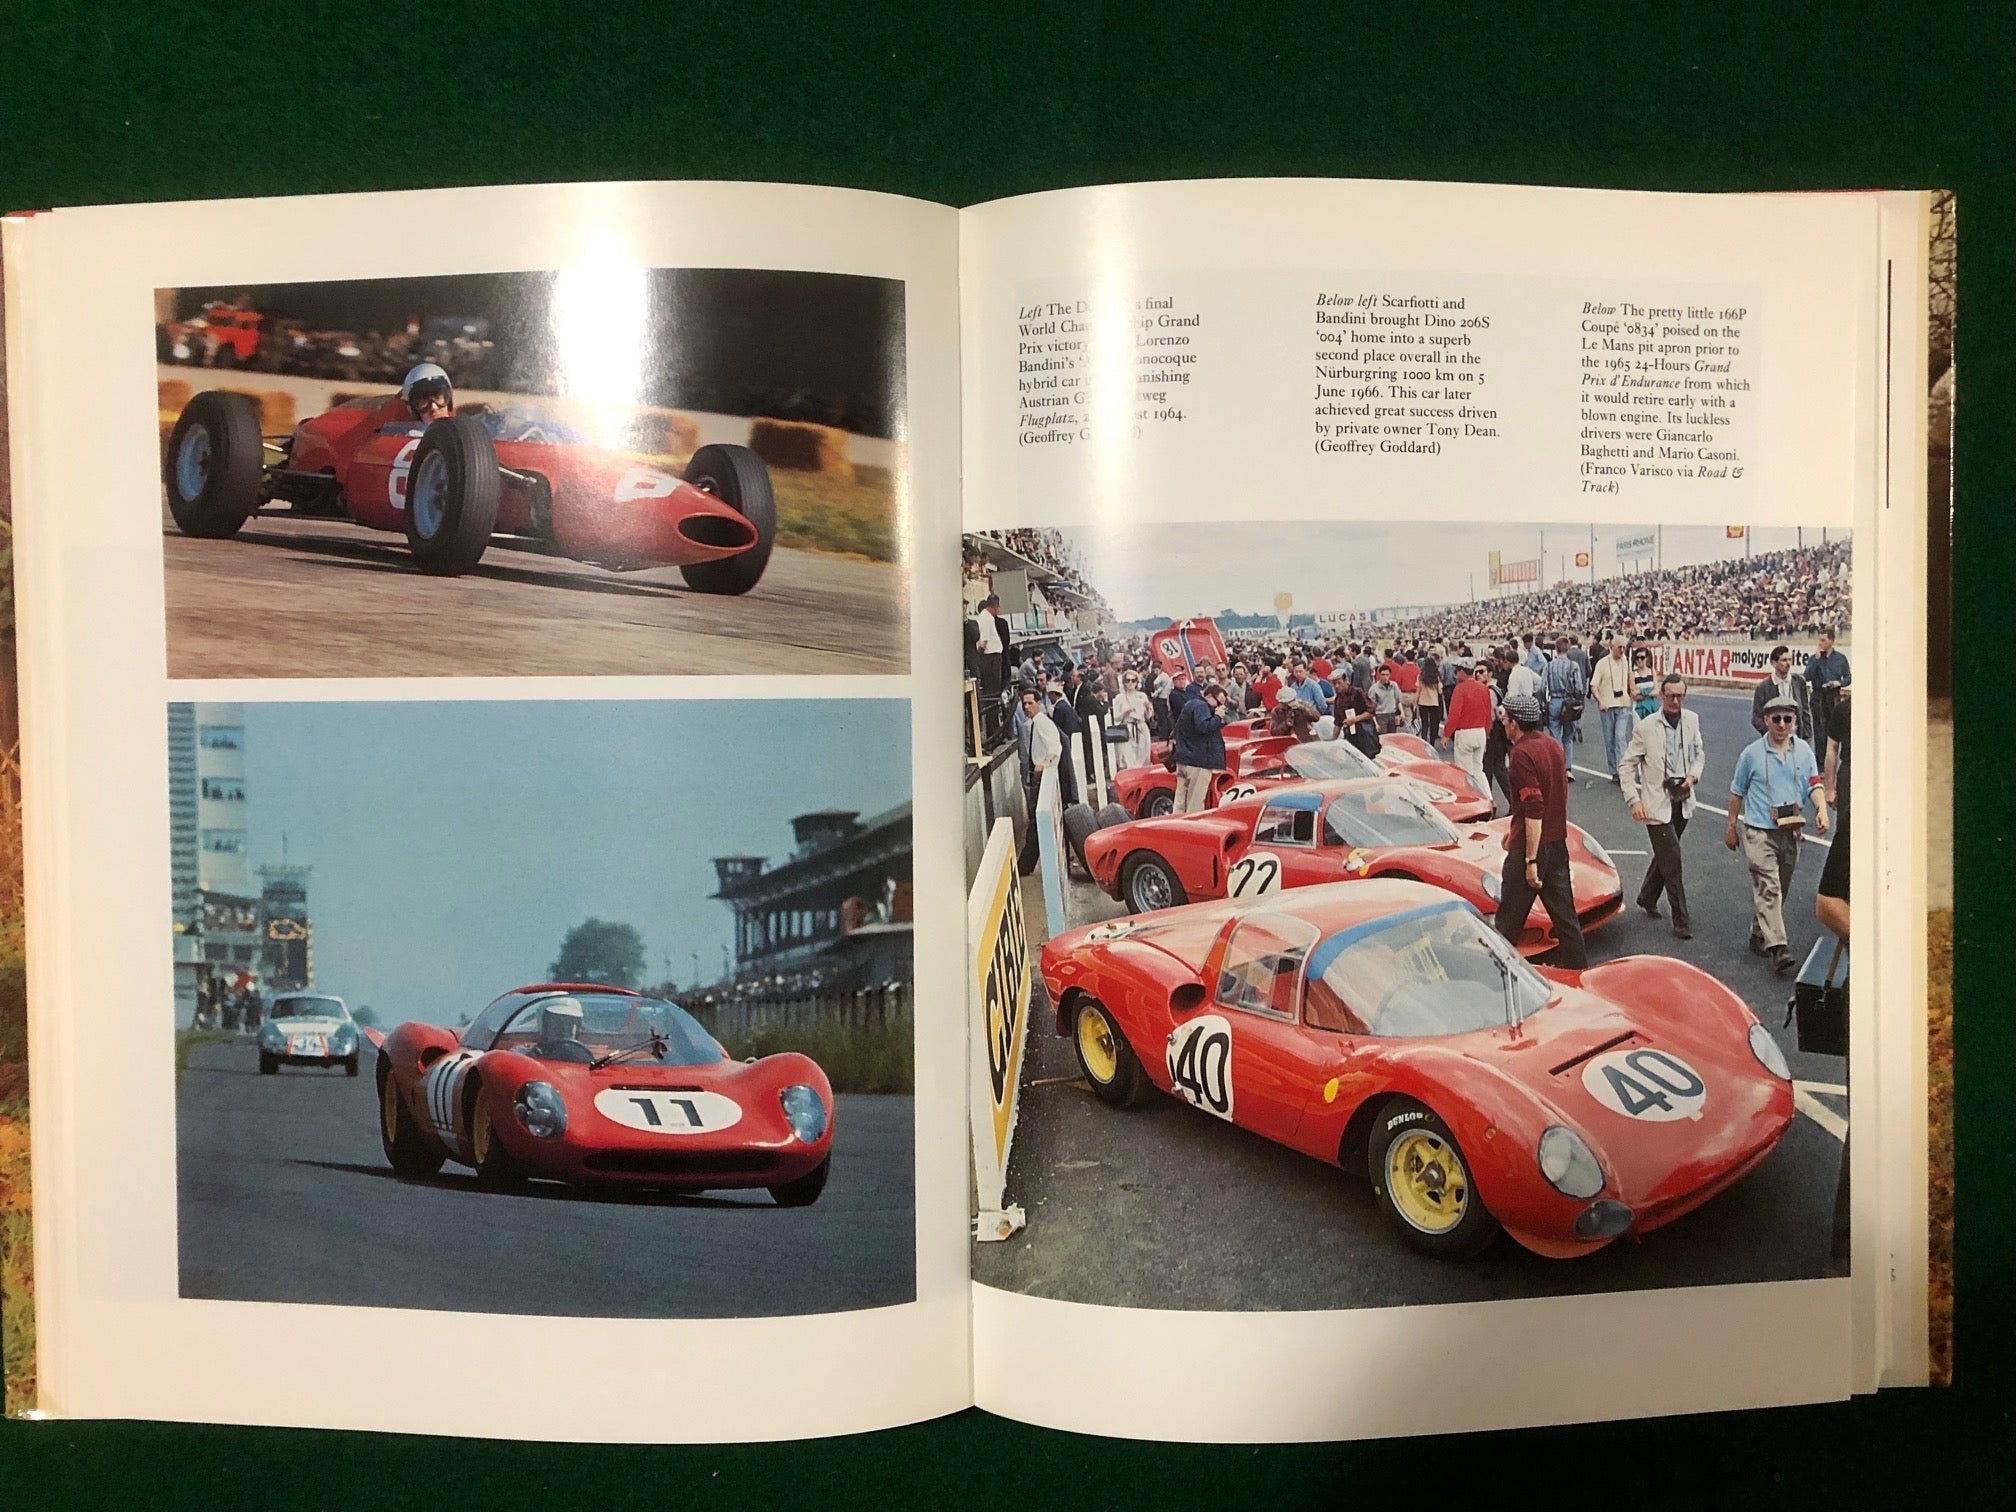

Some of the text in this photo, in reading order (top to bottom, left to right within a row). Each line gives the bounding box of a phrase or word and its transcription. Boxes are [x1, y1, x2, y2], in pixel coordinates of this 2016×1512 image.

[1019, 306, 1042, 320] Left
[1046, 304, 1072, 316] The
[1145, 297, 1173, 309] final
[1317, 294, 1465, 309] Below left Scarfiotti and
[1316, 311, 1490, 328] Bandini brought Dino 206S
[1582, 302, 1746, 320] Below The pretty little 166P
[1019, 322, 1055, 337] World
[1158, 314, 1200, 328] Grand
[1582, 320, 1619, 334] Coupé
[1663, 324, 1699, 337] poised
[1704, 327, 1717, 337] on
[1722, 325, 1740, 337] the
[1019, 342, 1042, 355] Prix
[1137, 334, 1190, 346] Lorenzo
[1351, 331, 1385, 343] home
[1390, 331, 1414, 344] into
[1419, 335, 1424, 344] a
[1429, 334, 1470, 347] superb
[1582, 338, 1739, 357] Le Mans pit apron prior to
[1315, 349, 1480, 364] second place overall in the
[1582, 356, 1730, 373] the 1965 24-Hours Grand
[1316, 366, 1484, 385] Nürburgring 1000 km on 5
[1582, 374, 1606, 386] Prix
[1684, 377, 1711, 389] from
[1716, 378, 1750, 391] which
[1019, 376, 1057, 393] hybrid
[1062, 377, 1080, 387] car
[1315, 385, 1471, 400] June 1966. This car later
[1019, 394, 1069, 408] Austrian
[1581, 391, 1735, 409] it would retire early with a
[1019, 412, 1078, 427] Flugplatz,
[1154, 407, 1187, 422] 1964.
[1315, 403, 1497, 419] achieved great success driven
[1581, 409, 1730, 425] blown engine. Its luckless
[1019, 430, 1074, 446] (Geoffrey
[1316, 422, 1500, 438] by private owner Tony Dean.
[1581, 427, 1713, 442] drivers were Giancarlo
[1315, 440, 1441, 455] (Geoffrey Goddard)
[1581, 444, 1740, 461] Baghetti and Mario Casoni.
[1581, 462, 1744, 478] (Franco Varisco via Road &
[1582, 480, 1619, 495] Track)
[1319, 612, 1367, 623] LUCAS
[1673, 648, 1731, 677] ANTAR
[1169, 1025, 1231, 1114] 40
[1601, 1050, 1704, 1116] 40
[628, 1098, 704, 1127] 11
[1387, 1112, 1423, 1130] DUNLOP
